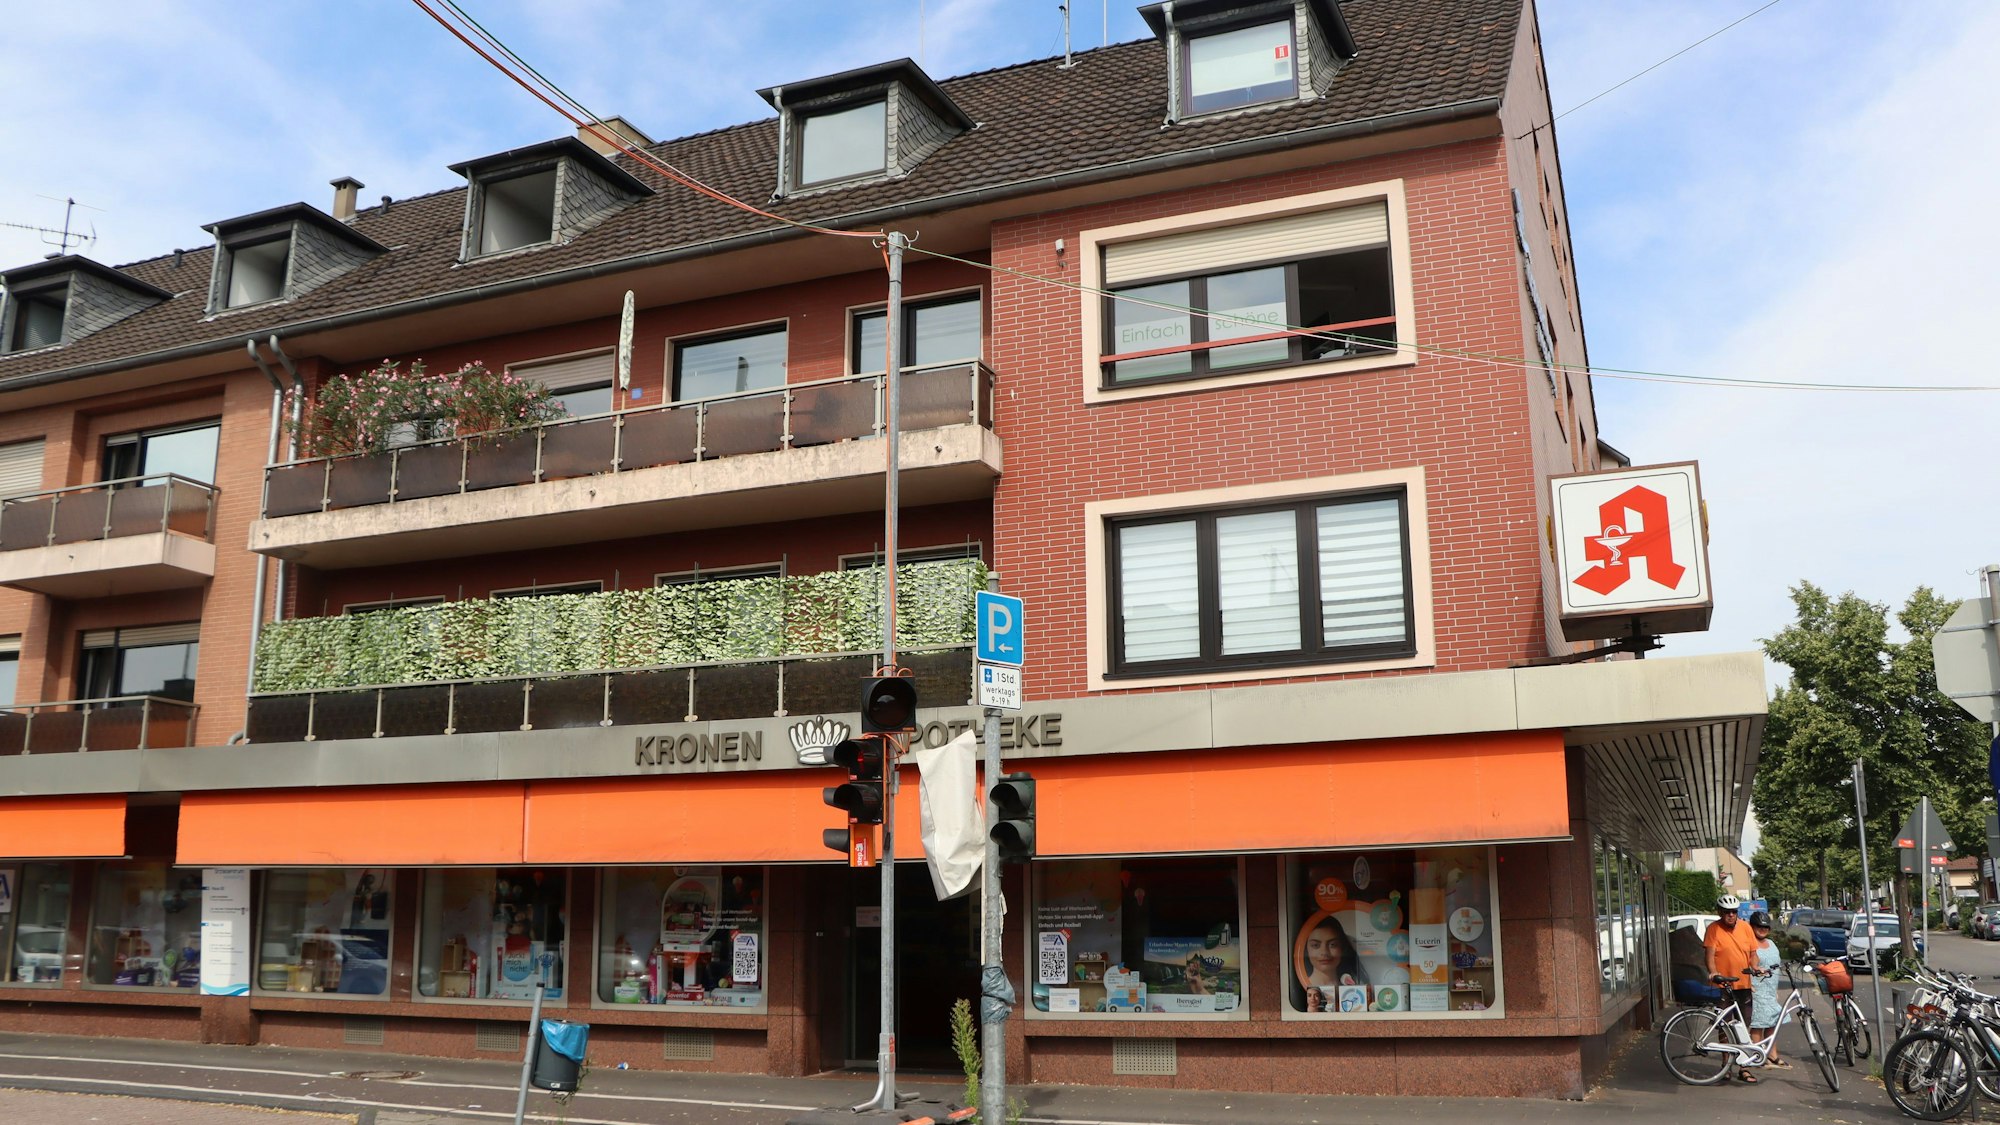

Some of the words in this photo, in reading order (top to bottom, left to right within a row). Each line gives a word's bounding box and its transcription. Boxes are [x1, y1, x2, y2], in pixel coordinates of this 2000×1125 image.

[1122, 322, 1184, 343] Einfach
[1215, 310, 1279, 331] schöne
[988, 602, 1012, 652] P
[986, 686, 1016, 697] werktags
[996, 672, 1000, 682] 1
[635, 730, 762, 766] KRONEN
